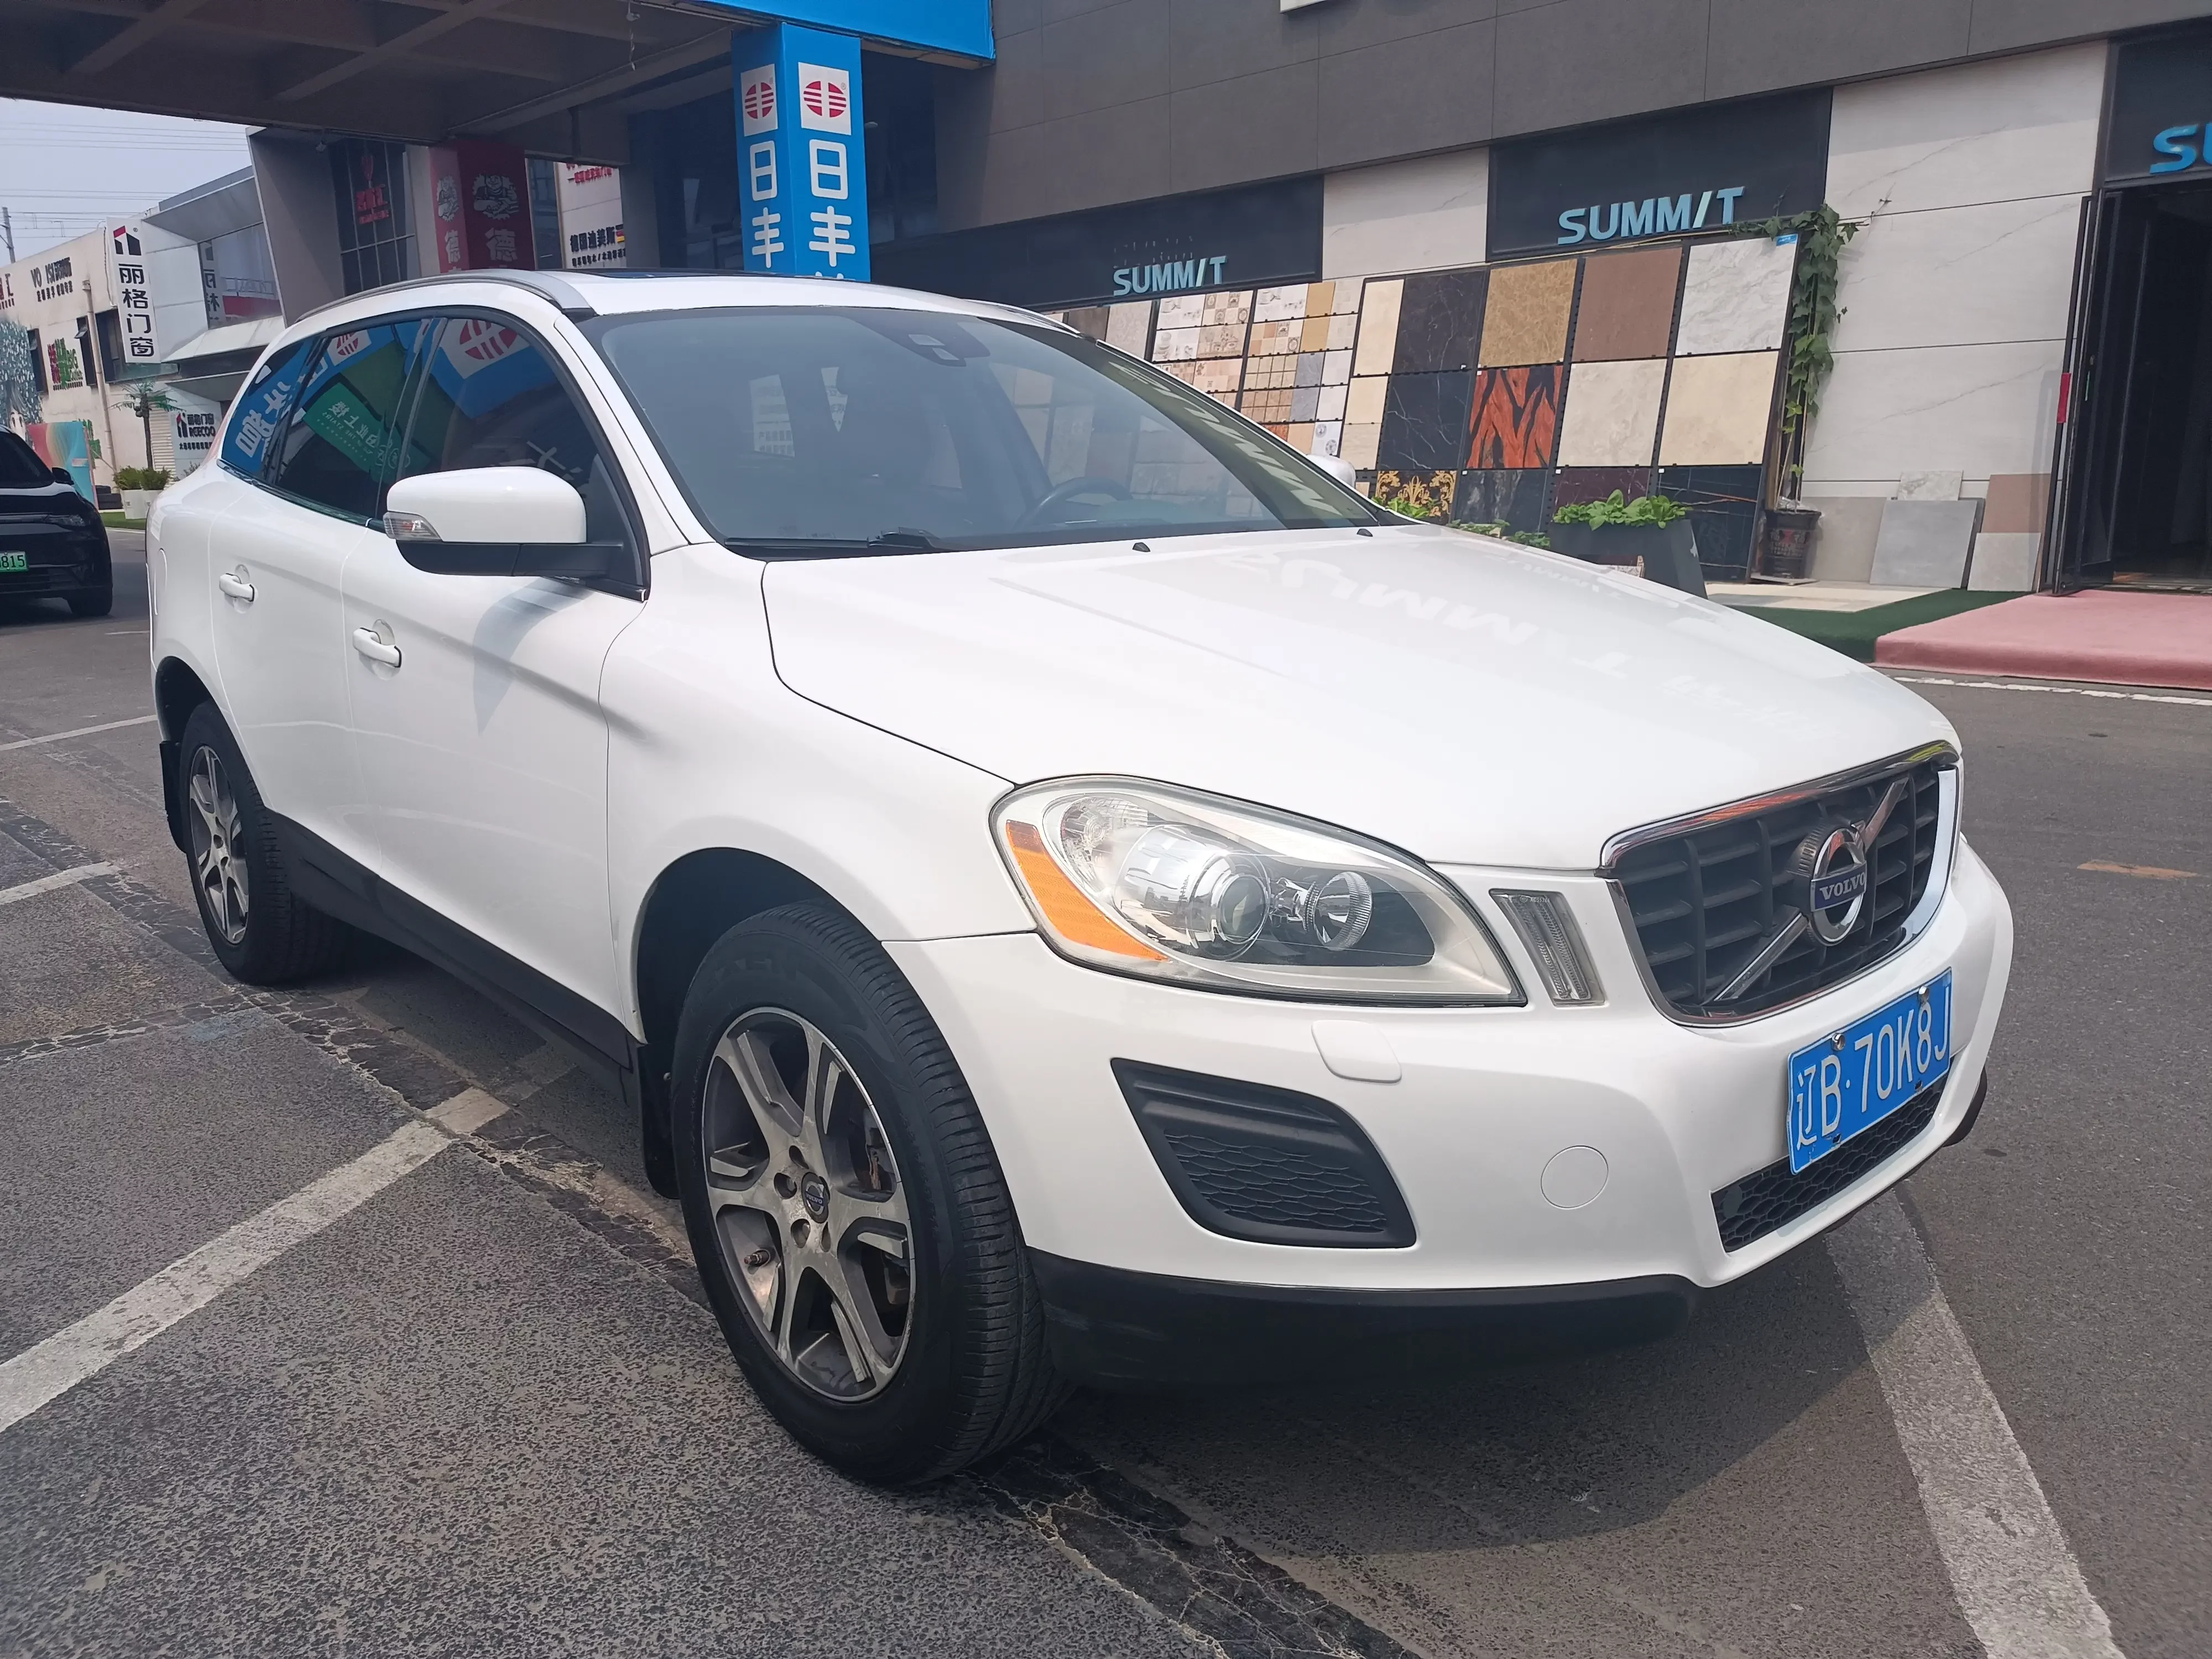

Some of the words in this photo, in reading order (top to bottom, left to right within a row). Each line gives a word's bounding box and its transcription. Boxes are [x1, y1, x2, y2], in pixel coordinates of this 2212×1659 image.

[2149, 122, 2212, 175] S
[750, 140, 784, 268] 日丰
[808, 138, 855, 281] 日丰
[1557, 186, 1745, 245] SUMMIT
[445, 229, 461, 273] 德
[485, 227, 518, 269] 德
[1113, 255, 1226, 296] SUMMIT
[118, 263, 154, 357] 丽格门窗
[0, 555, 25, 568] 815
[1819, 871, 1866, 901] VOLVO
[807, 1194, 823, 1204] VOLVO
